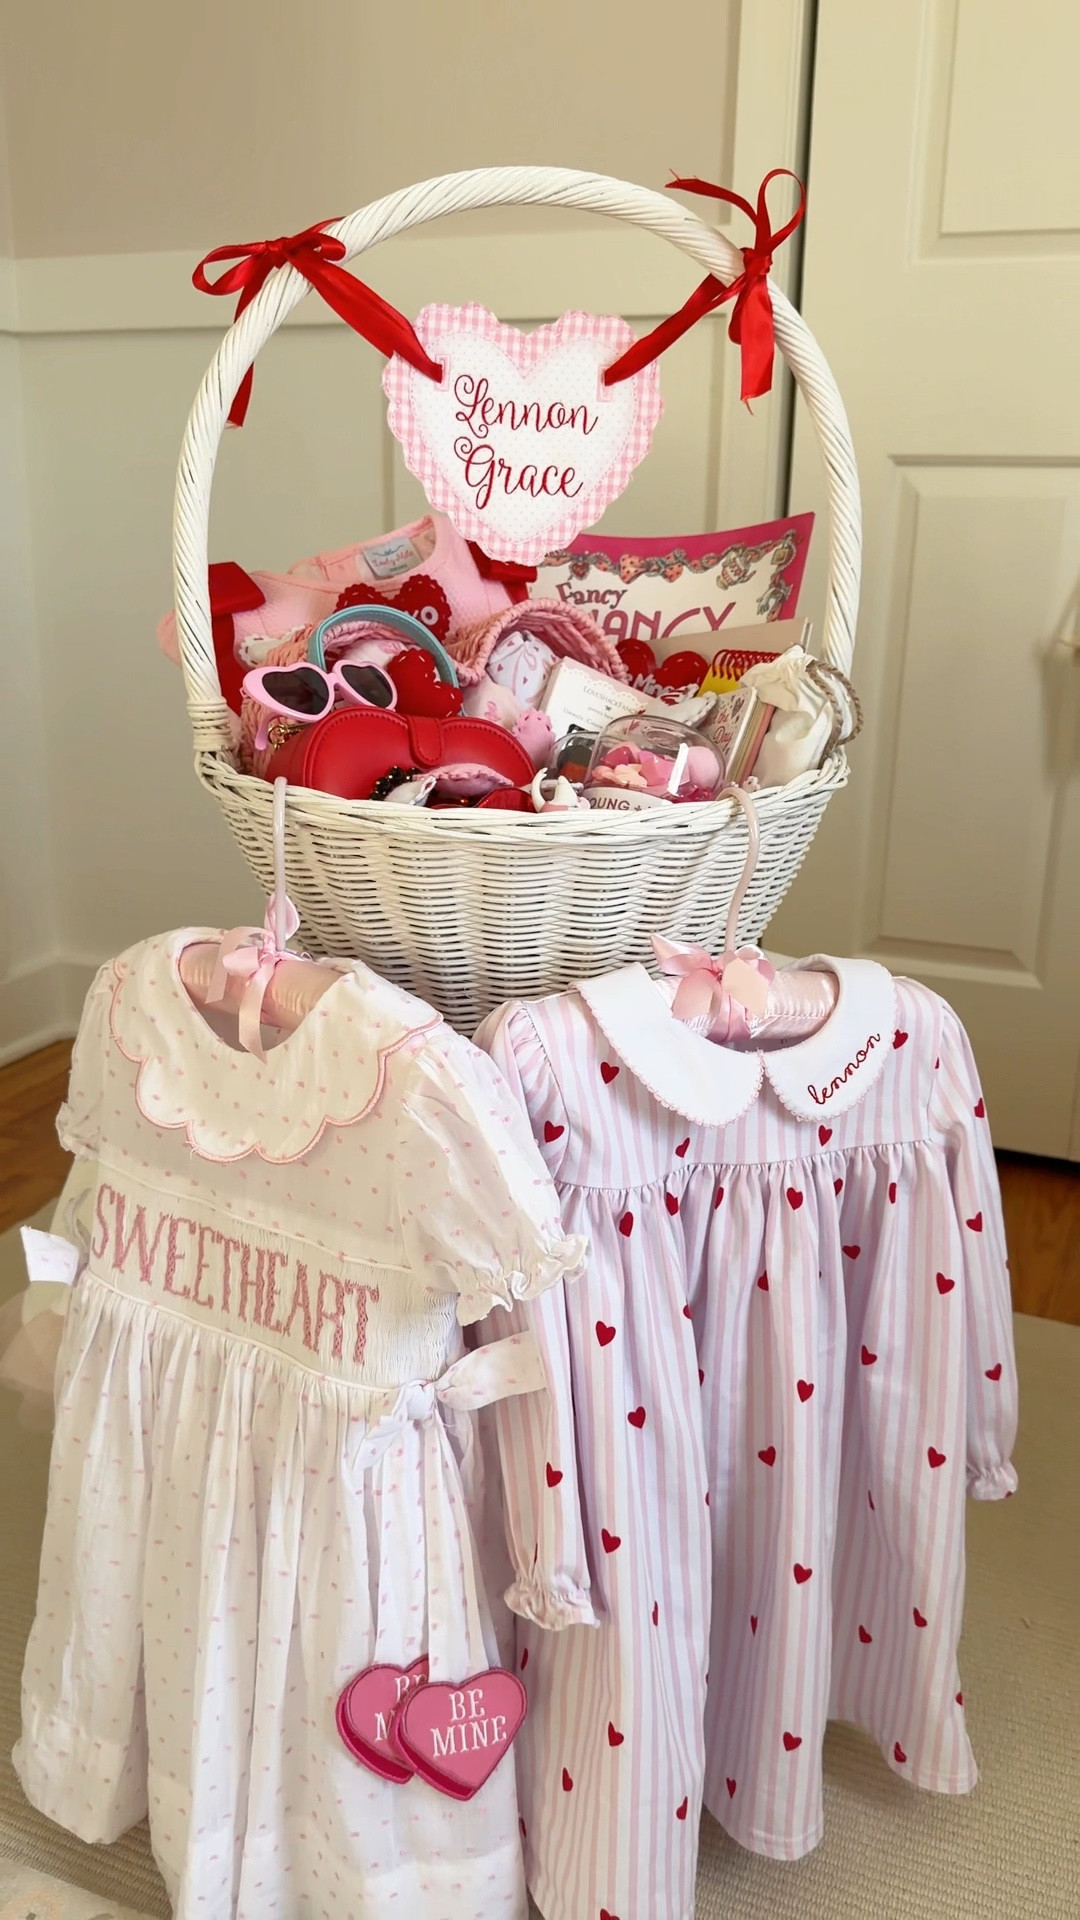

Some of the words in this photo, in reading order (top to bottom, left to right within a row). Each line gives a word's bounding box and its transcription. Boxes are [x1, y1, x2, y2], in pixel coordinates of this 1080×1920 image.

[454, 374, 599, 439] Lennon
[453, 436, 584, 510] Grace
[555, 581, 627, 609] Fancy
[589, 602, 736, 643] ANCY
[587, 797, 631, 812] OUNG
[807, 1033, 881, 1105] lennon
[92, 1183, 380, 1366] SWEETHEART
[448, 1688, 486, 1722] BE
[430, 1715, 508, 1758] MINE
